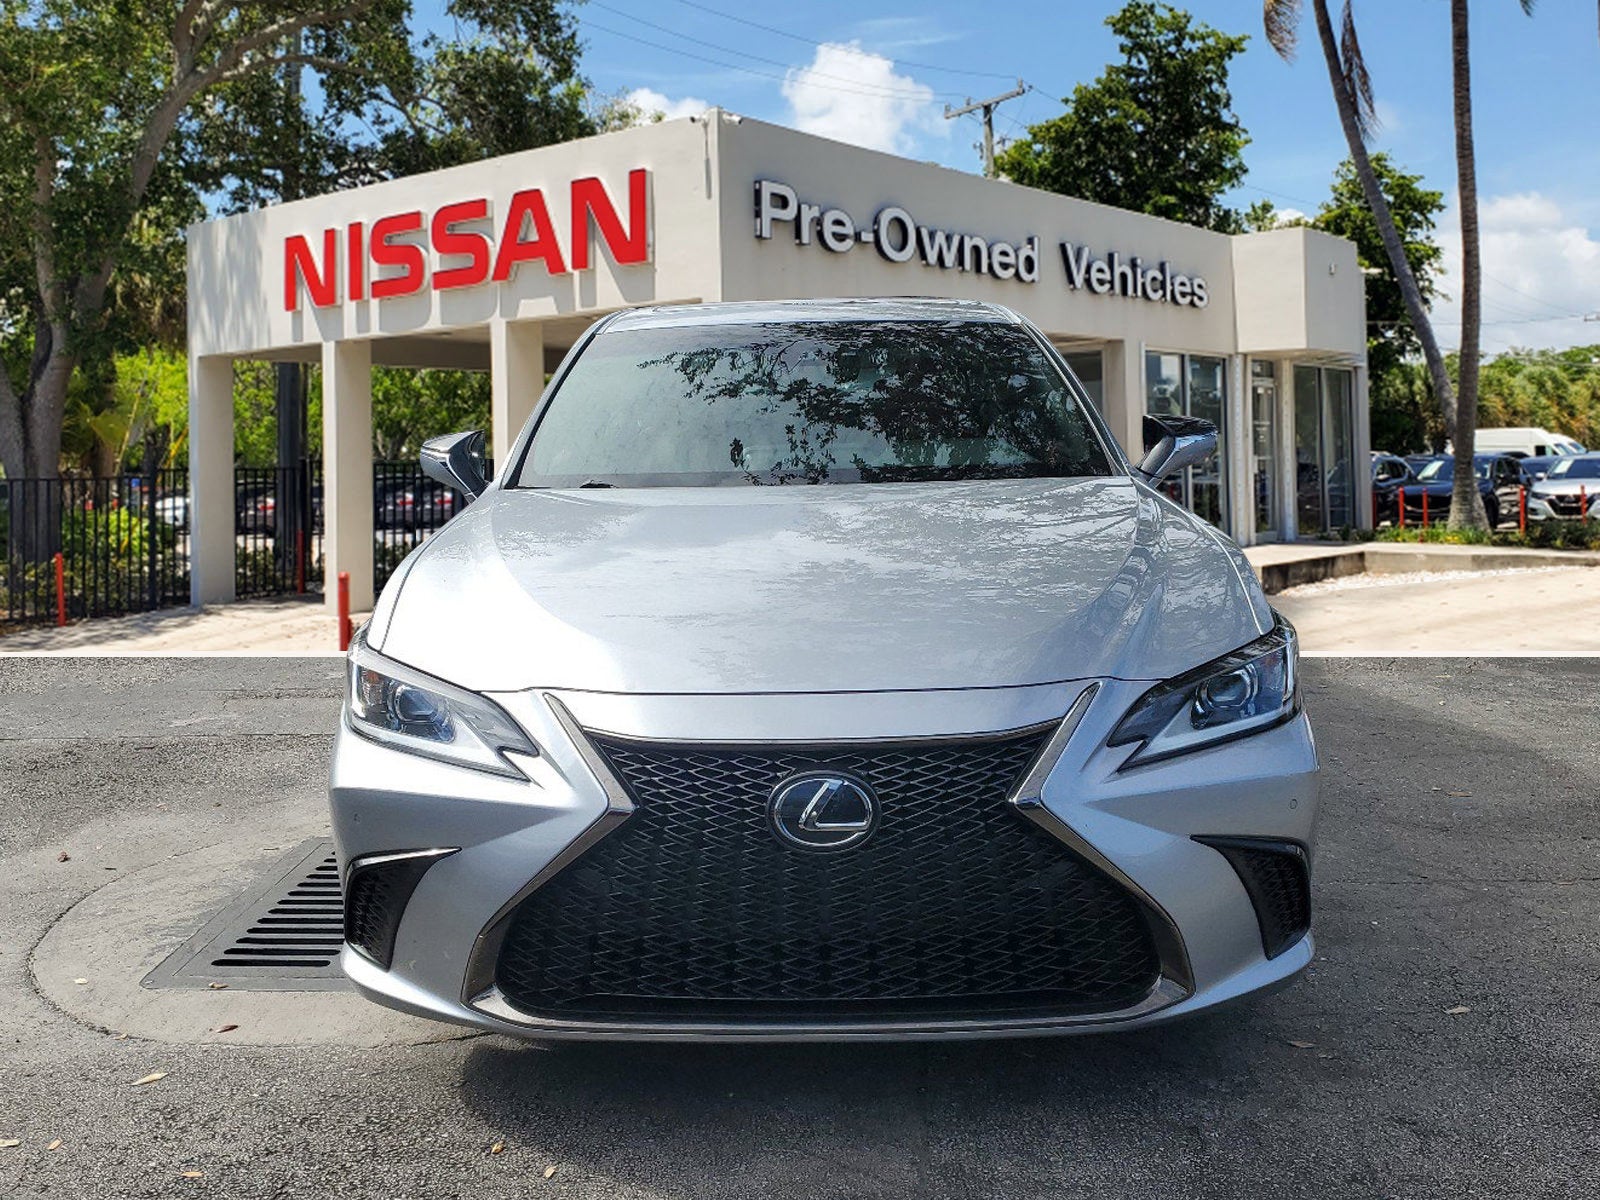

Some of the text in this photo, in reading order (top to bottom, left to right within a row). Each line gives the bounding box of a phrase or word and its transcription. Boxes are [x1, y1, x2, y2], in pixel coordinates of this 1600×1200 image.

[285, 168, 649, 312] NISSAN
[755, 179, 1209, 308] Pre-Owned Vehicles
